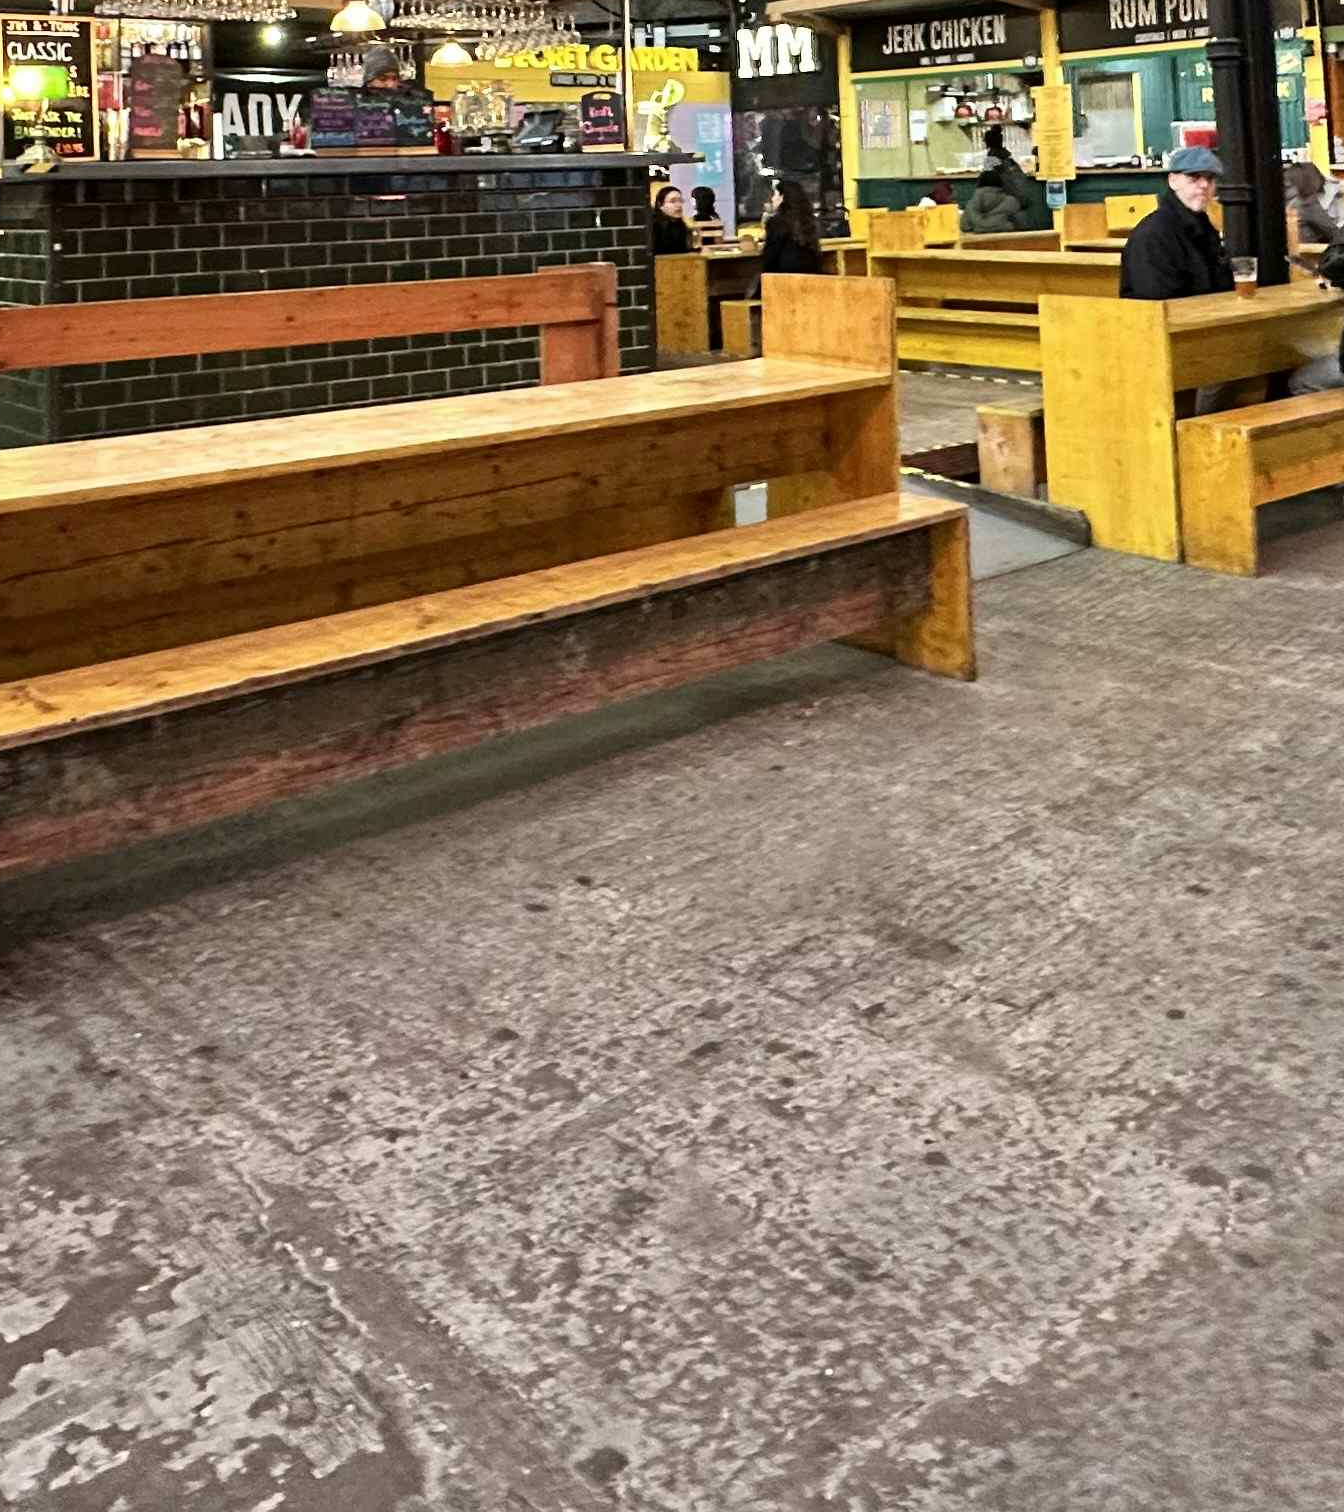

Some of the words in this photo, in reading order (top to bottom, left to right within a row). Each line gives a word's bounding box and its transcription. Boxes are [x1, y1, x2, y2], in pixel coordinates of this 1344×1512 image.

[7, 41, 73, 62] CLASSIC
[736, 23, 816, 79] MM
[882, 23, 927, 55] JERK
[929, 15, 1006, 51] CHICKEN
